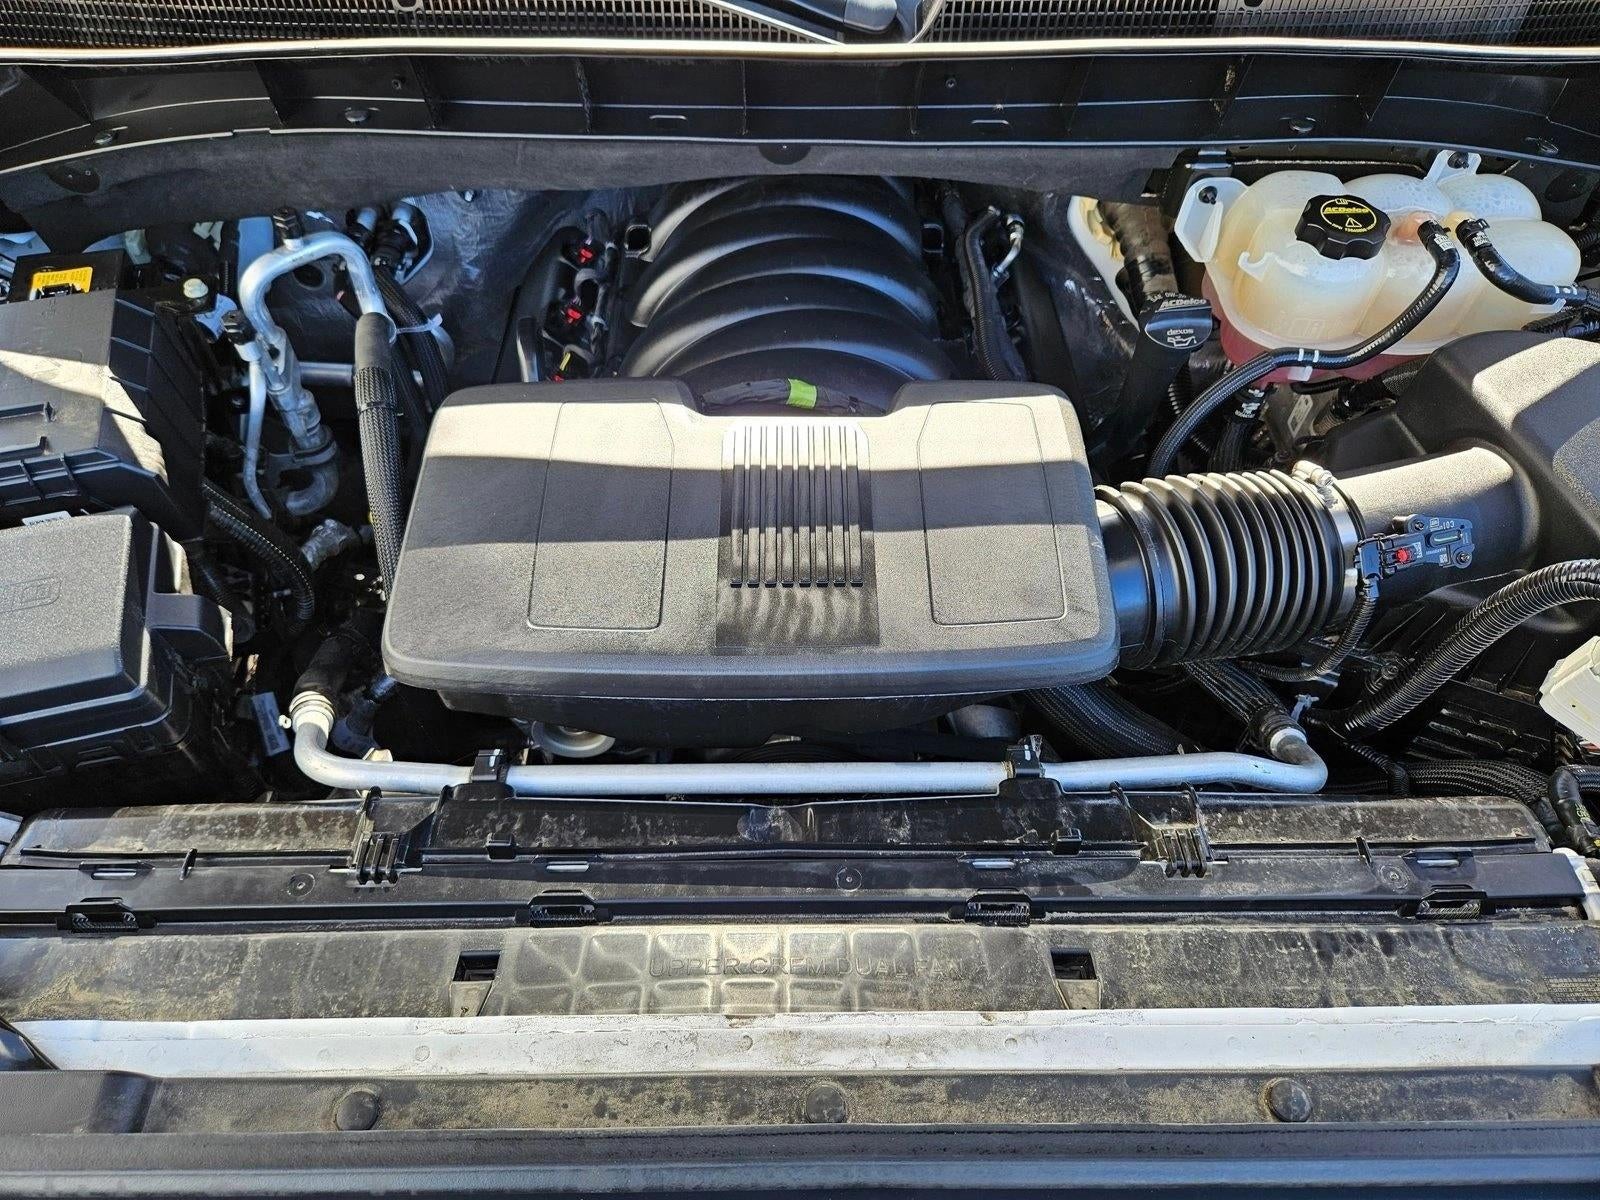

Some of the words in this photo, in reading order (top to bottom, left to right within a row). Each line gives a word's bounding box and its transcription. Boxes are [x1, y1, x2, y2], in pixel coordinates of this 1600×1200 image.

[1159, 299, 1207, 309] ACDelco
[1166, 328, 1194, 336] dexos
[649, 957, 742, 977] UPPER
[836, 957, 908, 977] DUAL
[914, 957, 963, 977] FAN
